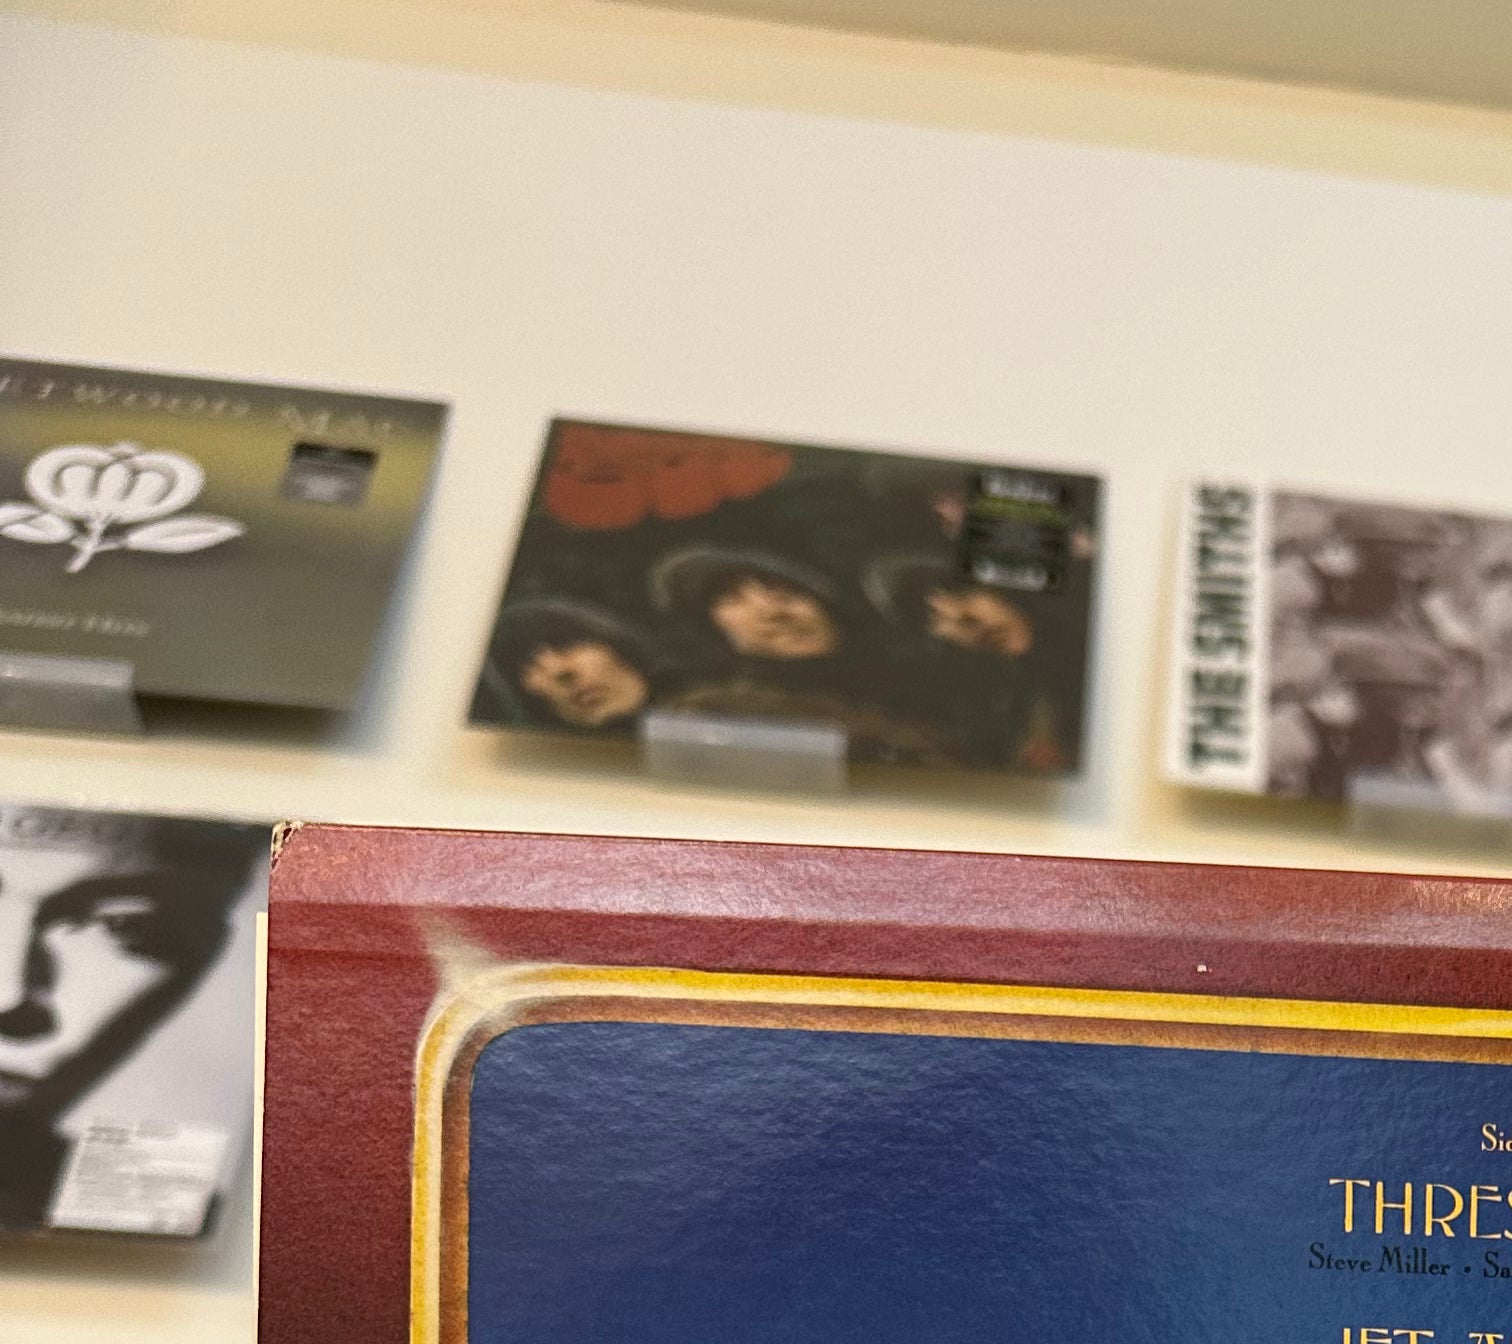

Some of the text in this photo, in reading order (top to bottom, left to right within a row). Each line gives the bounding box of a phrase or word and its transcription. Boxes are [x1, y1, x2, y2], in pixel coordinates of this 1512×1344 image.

[1186, 482, 1255, 768] THE SMITHS
[1309, 1242, 1371, 1272] Steve
[1378, 1246, 1450, 1275] Miller
